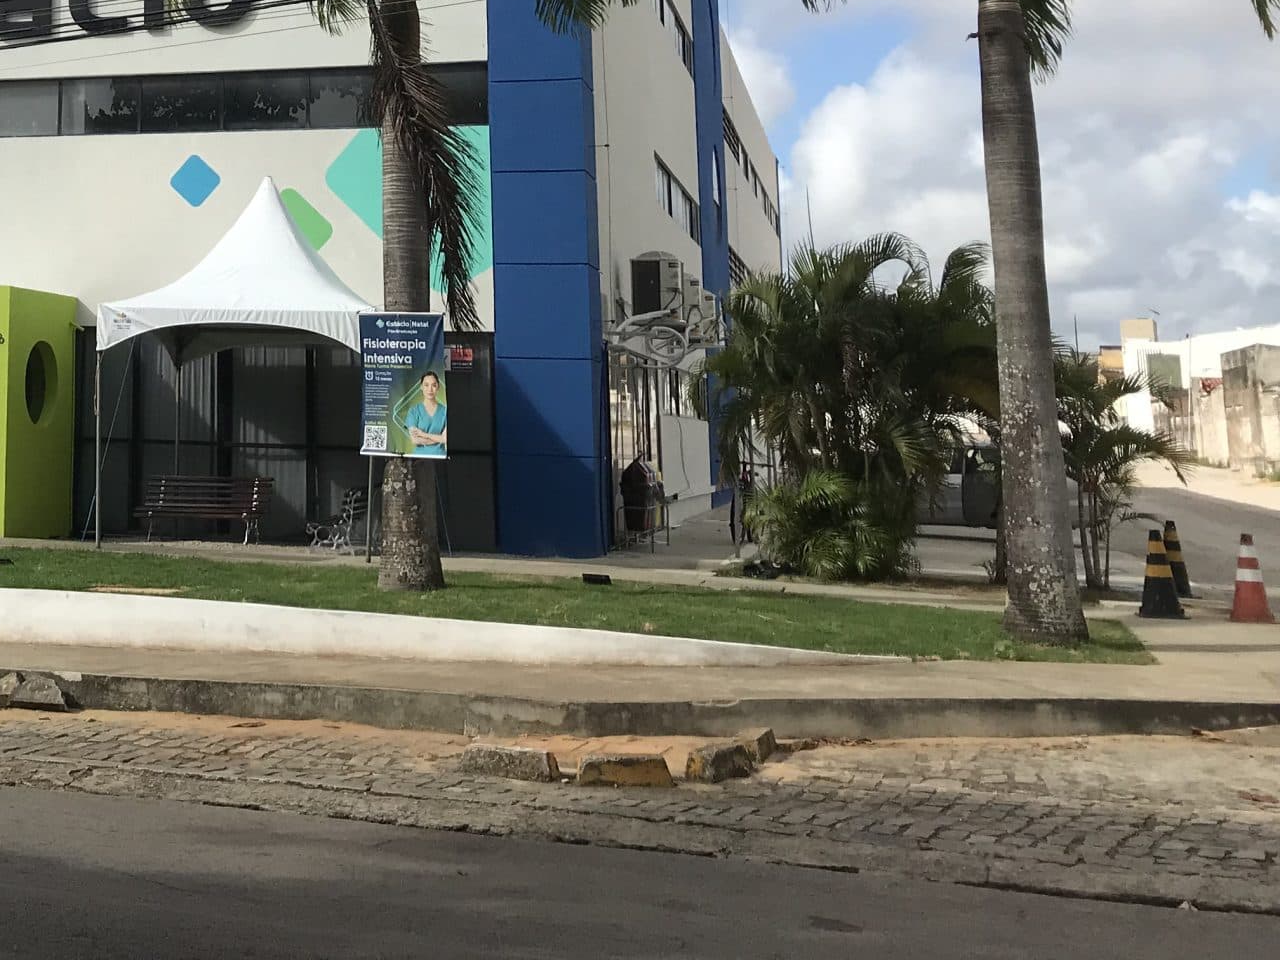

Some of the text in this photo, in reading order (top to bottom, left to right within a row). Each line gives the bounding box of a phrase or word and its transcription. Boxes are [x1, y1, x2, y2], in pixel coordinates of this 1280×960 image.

[411, 320, 429, 328] Natal
[363, 338, 426, 352] Fisioterapia
[363, 352, 413, 364] Intensiva
